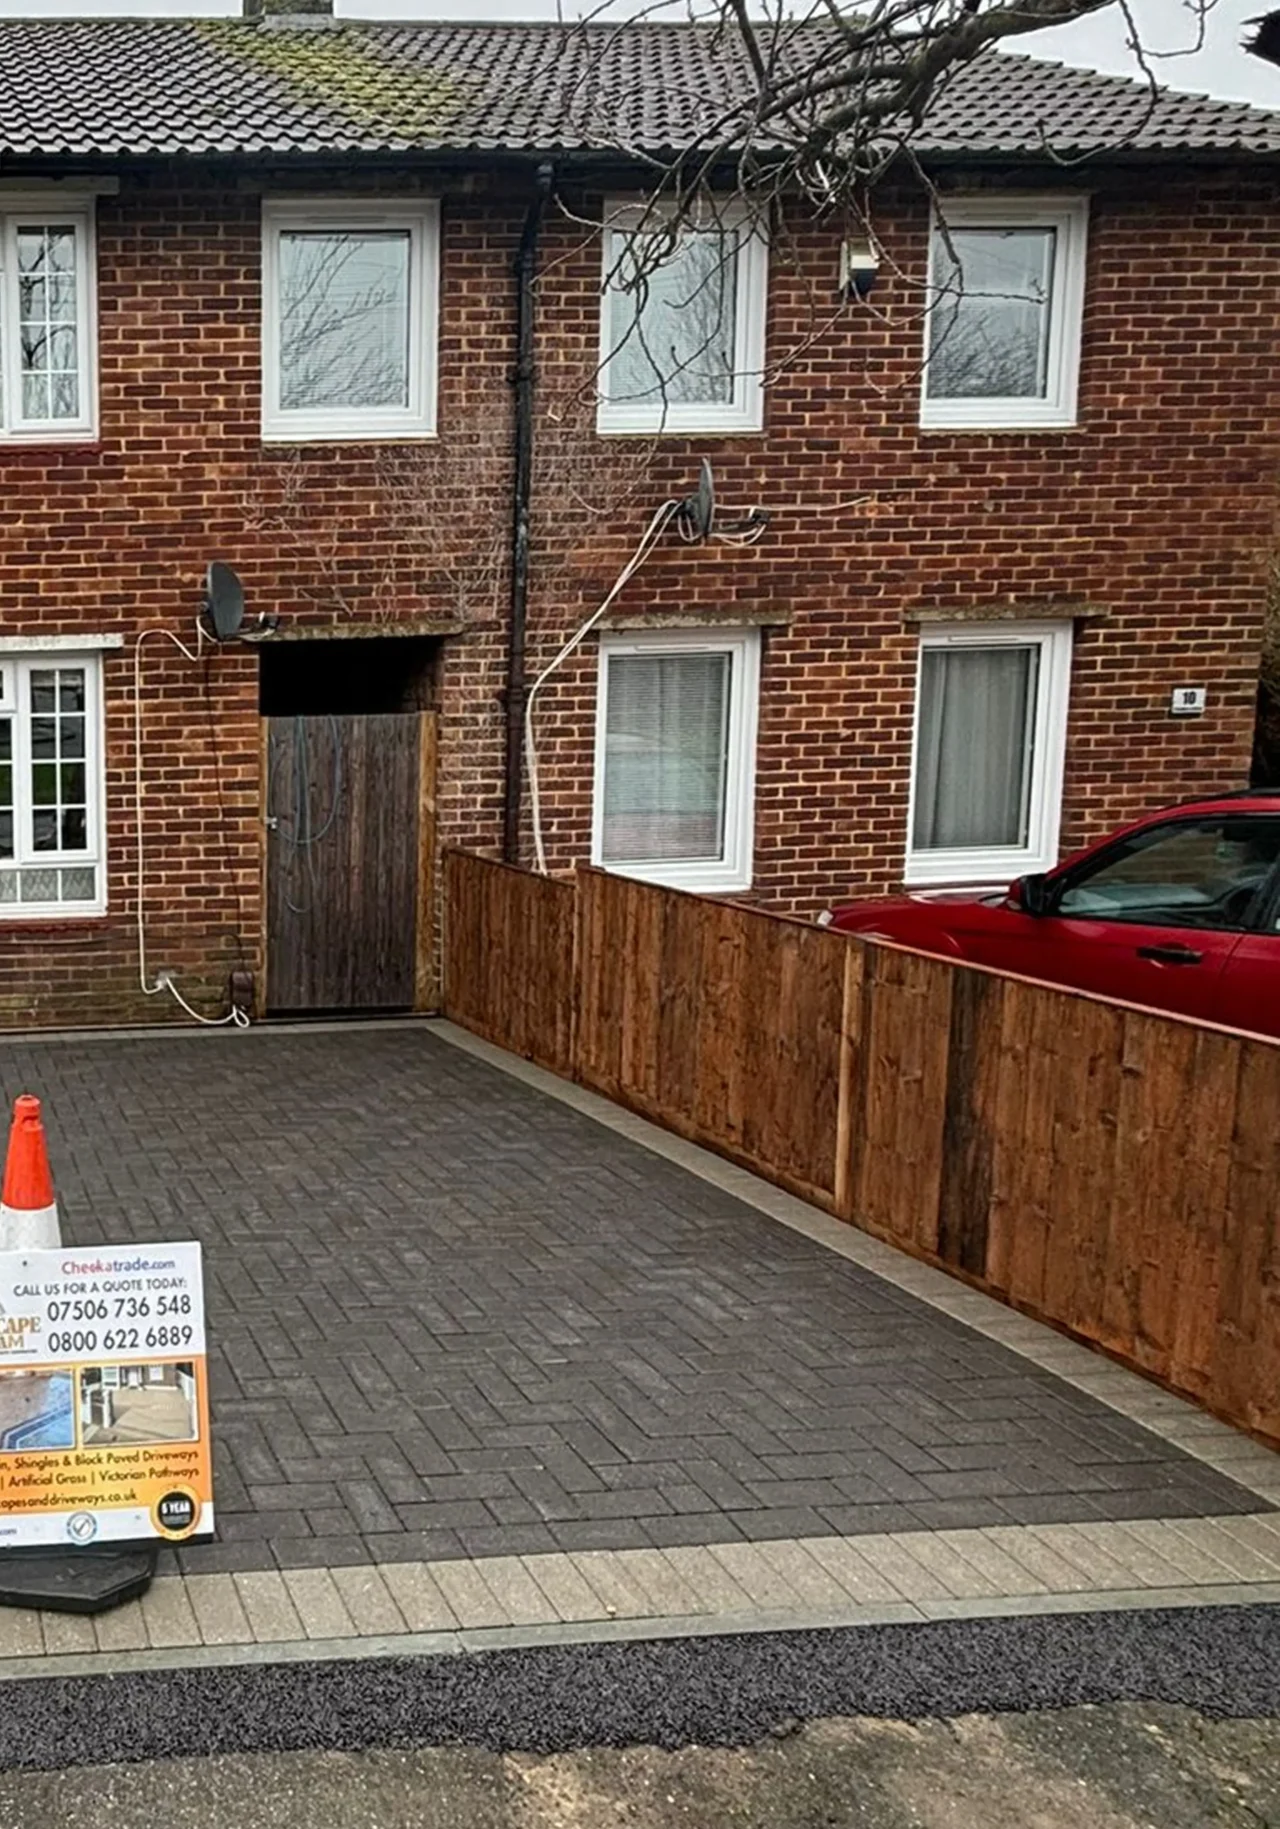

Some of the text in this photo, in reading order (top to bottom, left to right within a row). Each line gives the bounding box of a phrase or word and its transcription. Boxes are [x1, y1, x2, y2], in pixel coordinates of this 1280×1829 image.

[1183, 691, 1197, 705] 10
[61, 1257, 175, 1275] Checkatrade.com
[13, 1276, 188, 1297] CALL US FOR A QUOTE TODAY:
[47, 1294, 191, 1322] 07506 736 548
[48, 1324, 193, 1353] 0800 622 6889
[14, 1454, 60, 1471] Shingles
[63, 1454, 72, 1466] &
[75, 1451, 104, 1466] Block
[107, 1450, 140, 1464] Paved
[143, 1448, 199, 1462] Driveways
[9, 1472, 87, 1488] Artificial Grass
[99, 1465, 200, 1482] Victorian Pathways
